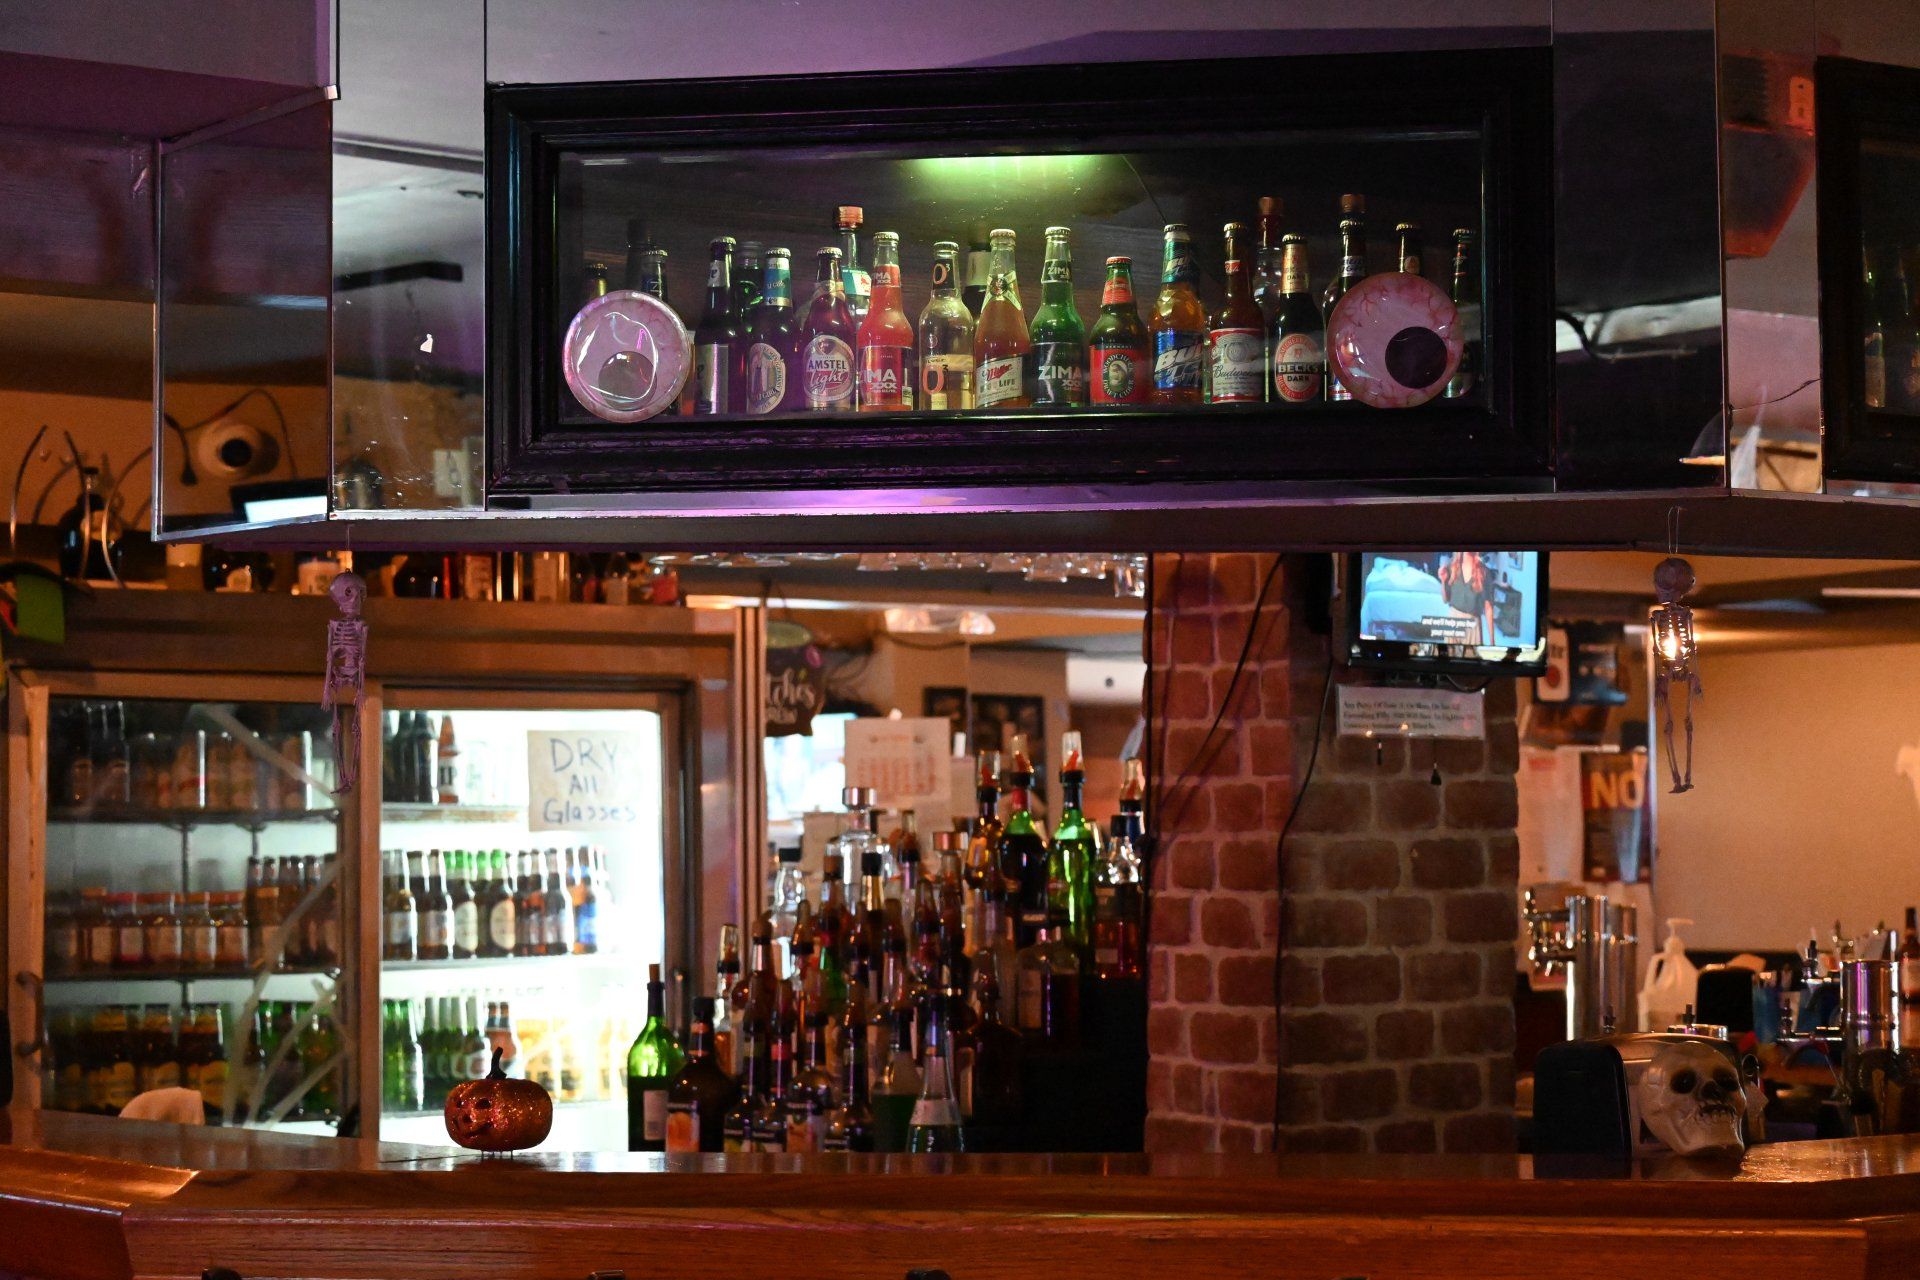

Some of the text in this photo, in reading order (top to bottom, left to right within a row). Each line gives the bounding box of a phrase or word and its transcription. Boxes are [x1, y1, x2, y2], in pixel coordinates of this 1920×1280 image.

[808, 359, 847, 370] AMSTEL
[1038, 366, 1082, 380] ZIMA
[810, 368, 844, 393] Light
[999, 378, 1016, 388] LIFE
[1287, 374, 1310, 382] DARK
[550, 737, 619, 774] DRY
[569, 773, 598, 796] All
[1589, 769, 1645, 810] NO
[543, 797, 637, 826] Glasses
